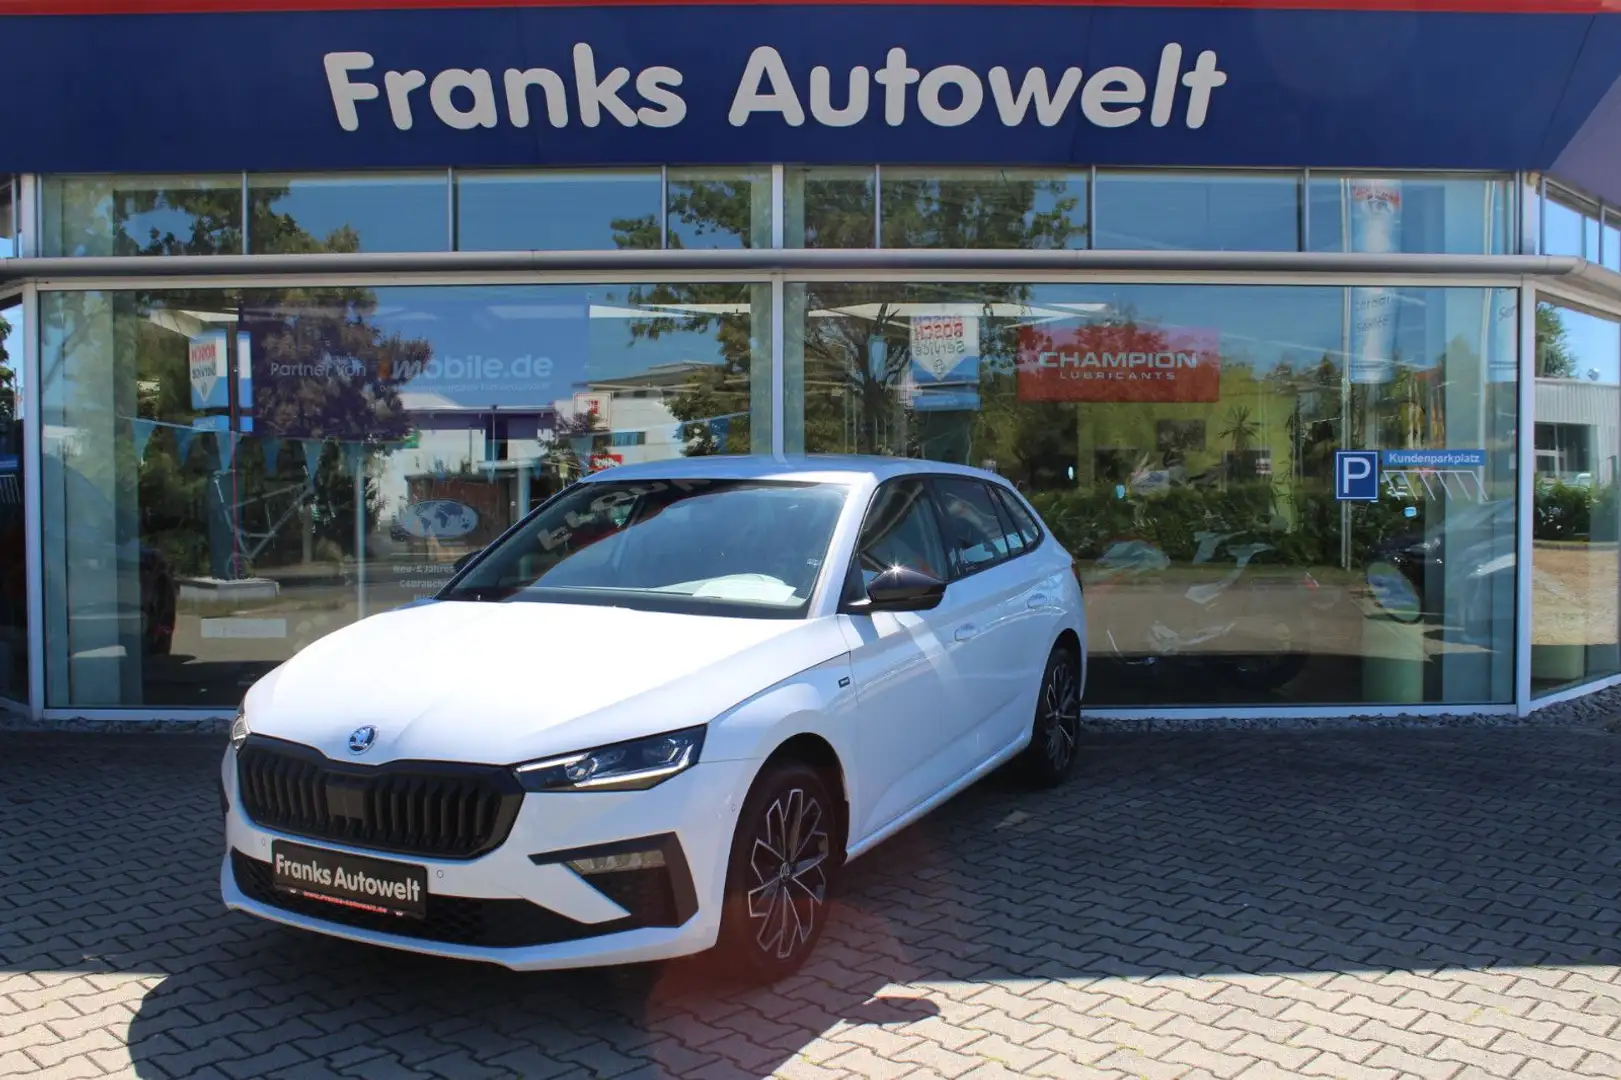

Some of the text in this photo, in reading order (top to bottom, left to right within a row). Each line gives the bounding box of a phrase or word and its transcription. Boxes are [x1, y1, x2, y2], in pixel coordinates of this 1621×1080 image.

[323, 42, 1228, 131] Franks Autowelt
[270, 361, 332, 377] Partner
[391, 354, 554, 380] mobile.de
[1038, 351, 1197, 369] CHAMPION
[1059, 371, 1177, 381] LUBRICANTS
[1388, 453, 1481, 465] Kundenparkplatz
[1343, 456, 1371, 494] P
[275, 852, 421, 903] Franks Autowelt
